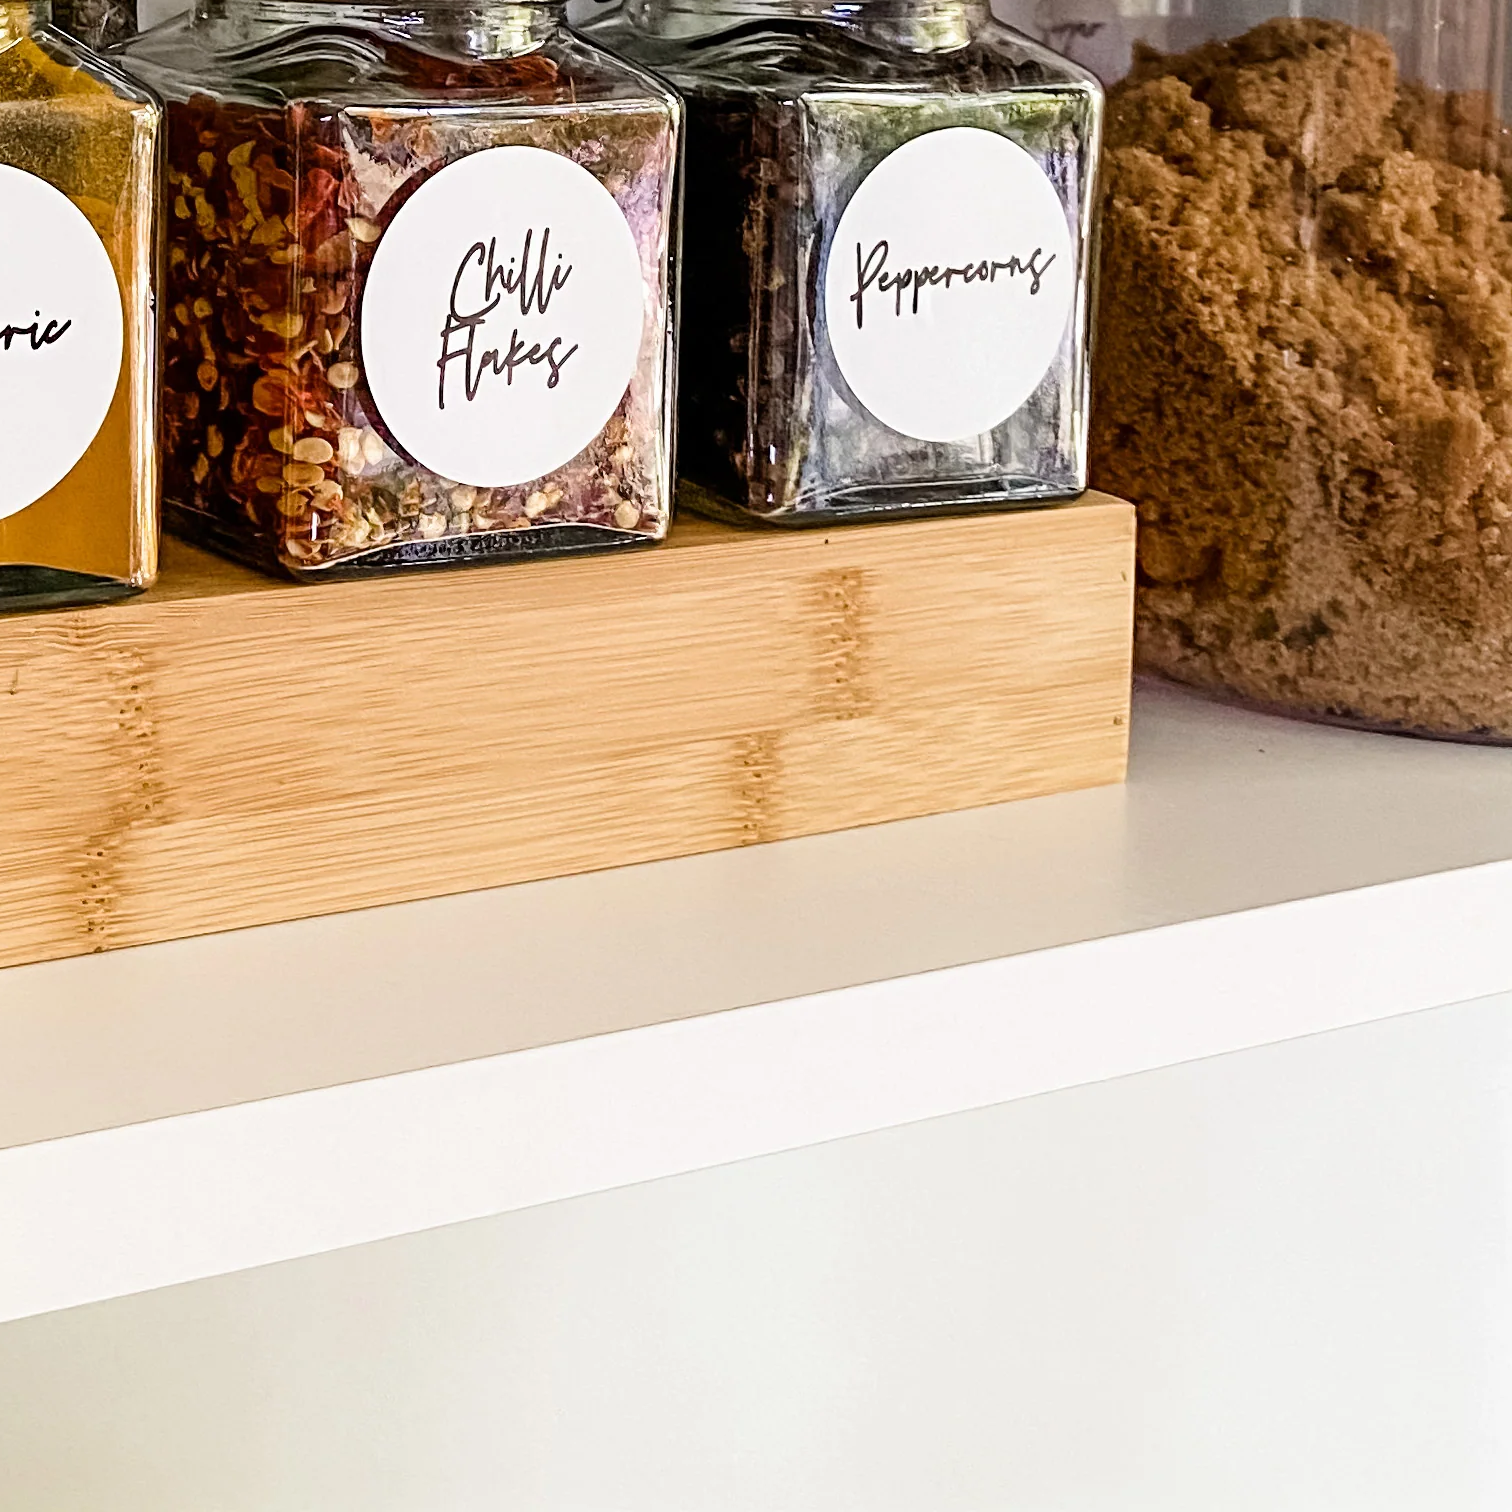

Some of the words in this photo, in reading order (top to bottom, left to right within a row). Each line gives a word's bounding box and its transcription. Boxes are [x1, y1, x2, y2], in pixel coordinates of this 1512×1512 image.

[450, 228, 572, 323] Chilli
[850, 240, 1056, 329] Peppercorns
[437, 314, 578, 409] Flakes
